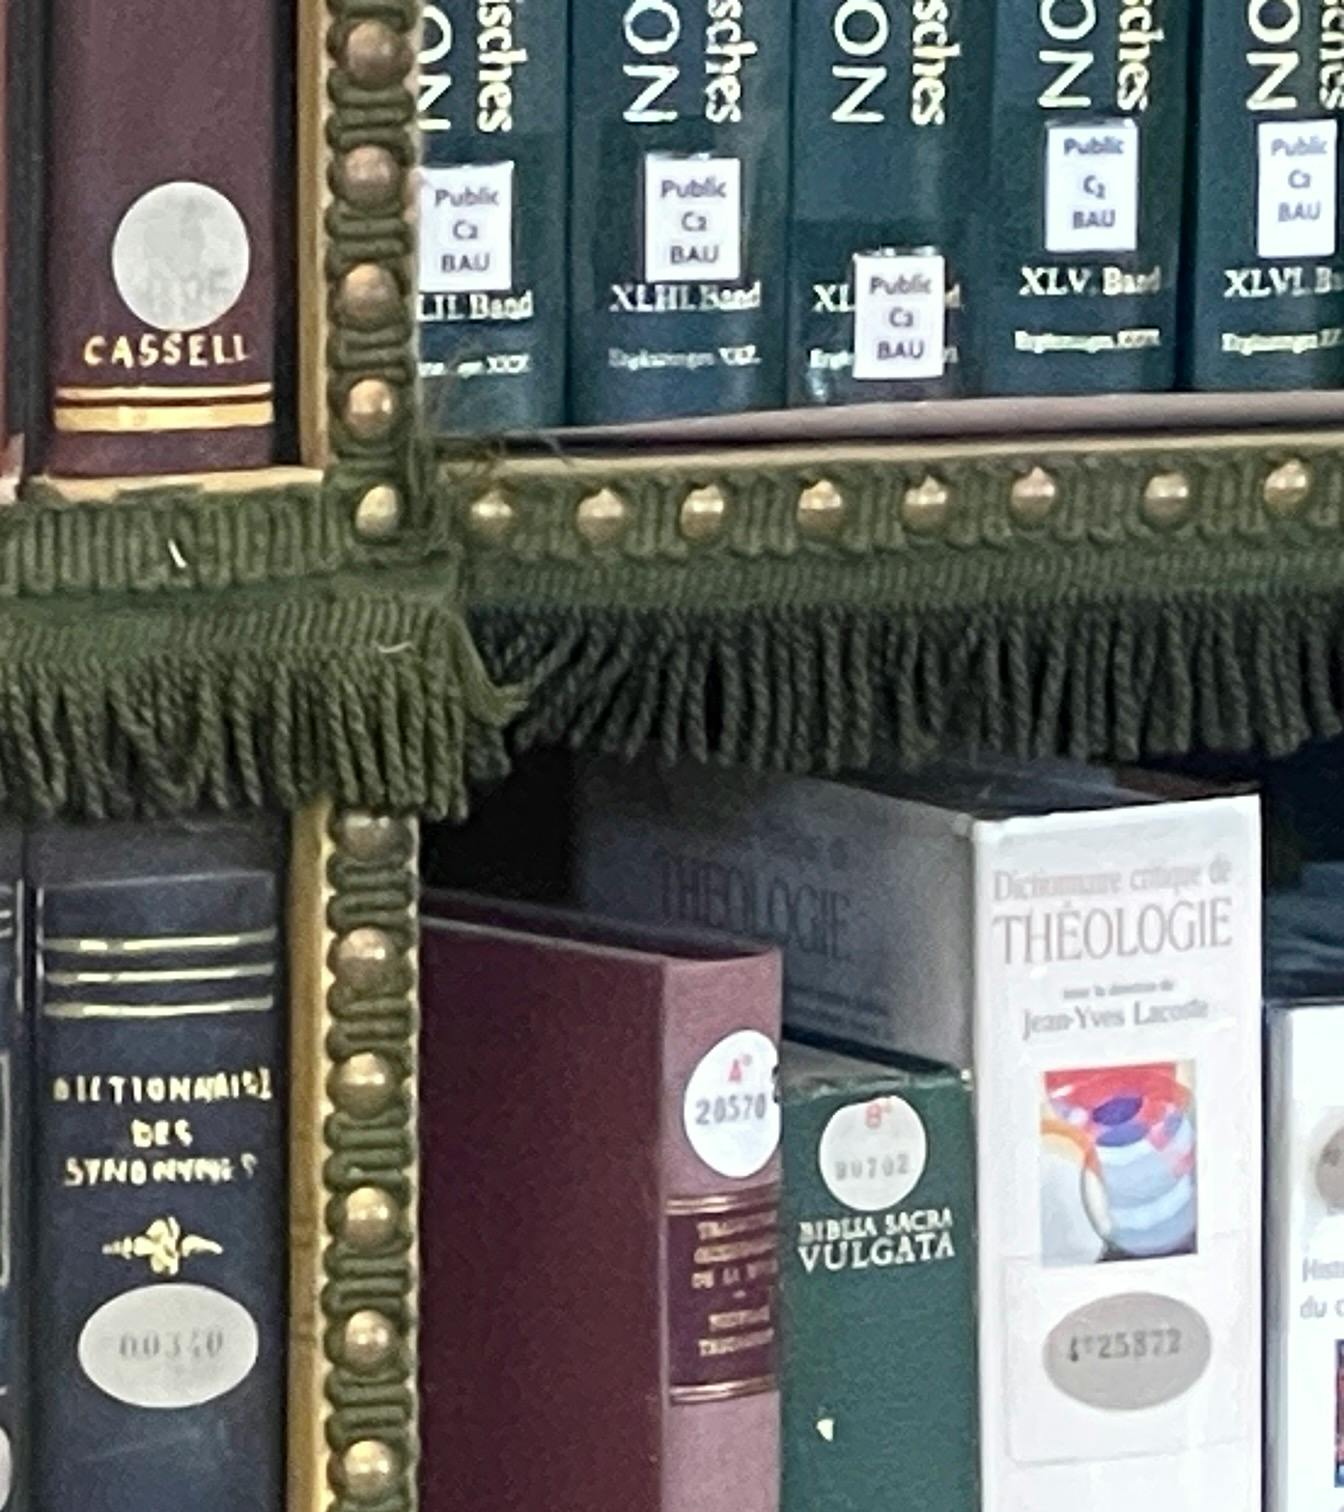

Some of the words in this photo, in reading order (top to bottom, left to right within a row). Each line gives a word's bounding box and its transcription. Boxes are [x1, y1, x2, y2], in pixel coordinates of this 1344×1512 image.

[1063, 136, 1125, 156] Public
[1270, 136, 1327, 157] Public
[434, 185, 500, 207] Public
[660, 175, 728, 199] Public
[1072, 208, 1116, 230] BAU
[1278, 202, 1321, 223] BAU
[441, 253, 491, 274] BAU
[669, 245, 720, 265] BAU
[869, 275, 933, 296] Public
[83, 332, 251, 368] CASSELL
[876, 340, 925, 362] BAU
[992, 869, 1123, 901] Dictionnaire
[1128, 861, 1203, 898] critique
[1208, 855, 1232, 886] de
[992, 897, 1234, 965] THÉOLOGIE
[1021, 1004, 1126, 1041] Jean-Yves
[695, 1092, 768, 1126] 20570
[130, 1118, 194, 1149] DES
[797, 1214, 878, 1243] BIBLIA
[884, 1206, 954, 1236] SACRA
[797, 1230, 956, 1273] VULGATA
